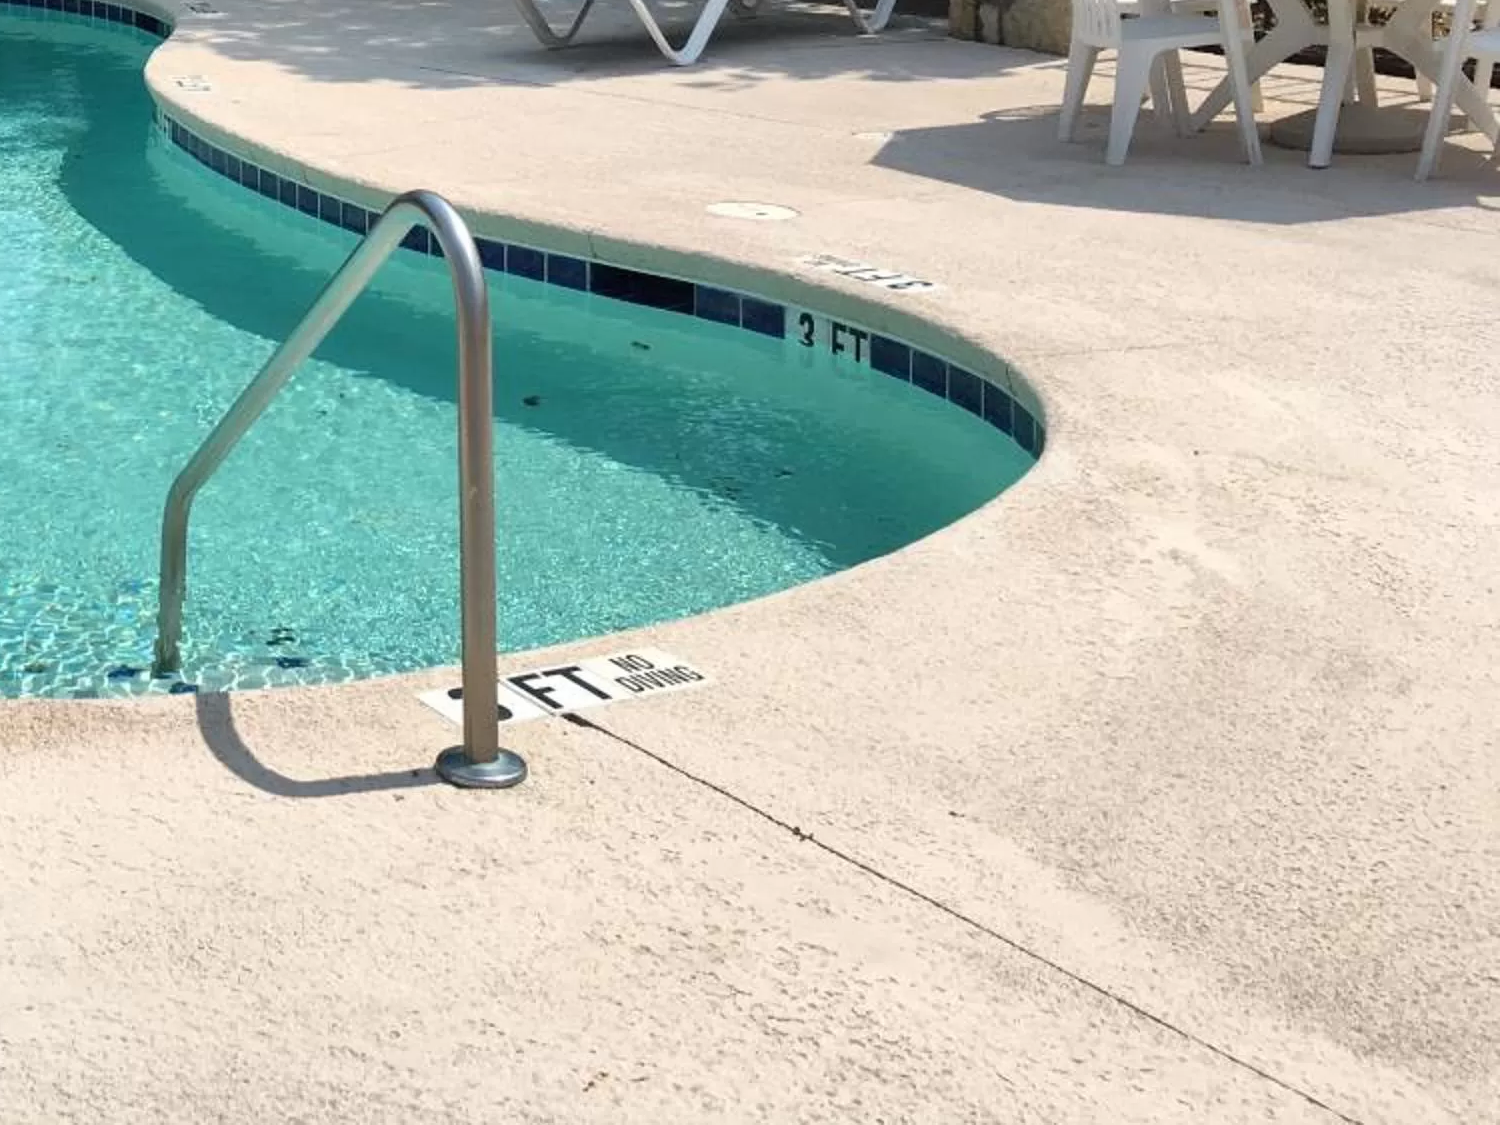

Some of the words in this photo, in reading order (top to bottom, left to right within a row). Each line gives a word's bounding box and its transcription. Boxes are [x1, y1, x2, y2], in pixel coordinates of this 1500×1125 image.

[799, 312, 815, 348] 3
[831, 322, 868, 363] FT
[507, 665, 613, 710] FT
[608, 653, 656, 673] NO
[615, 664, 705, 694] DIVING
